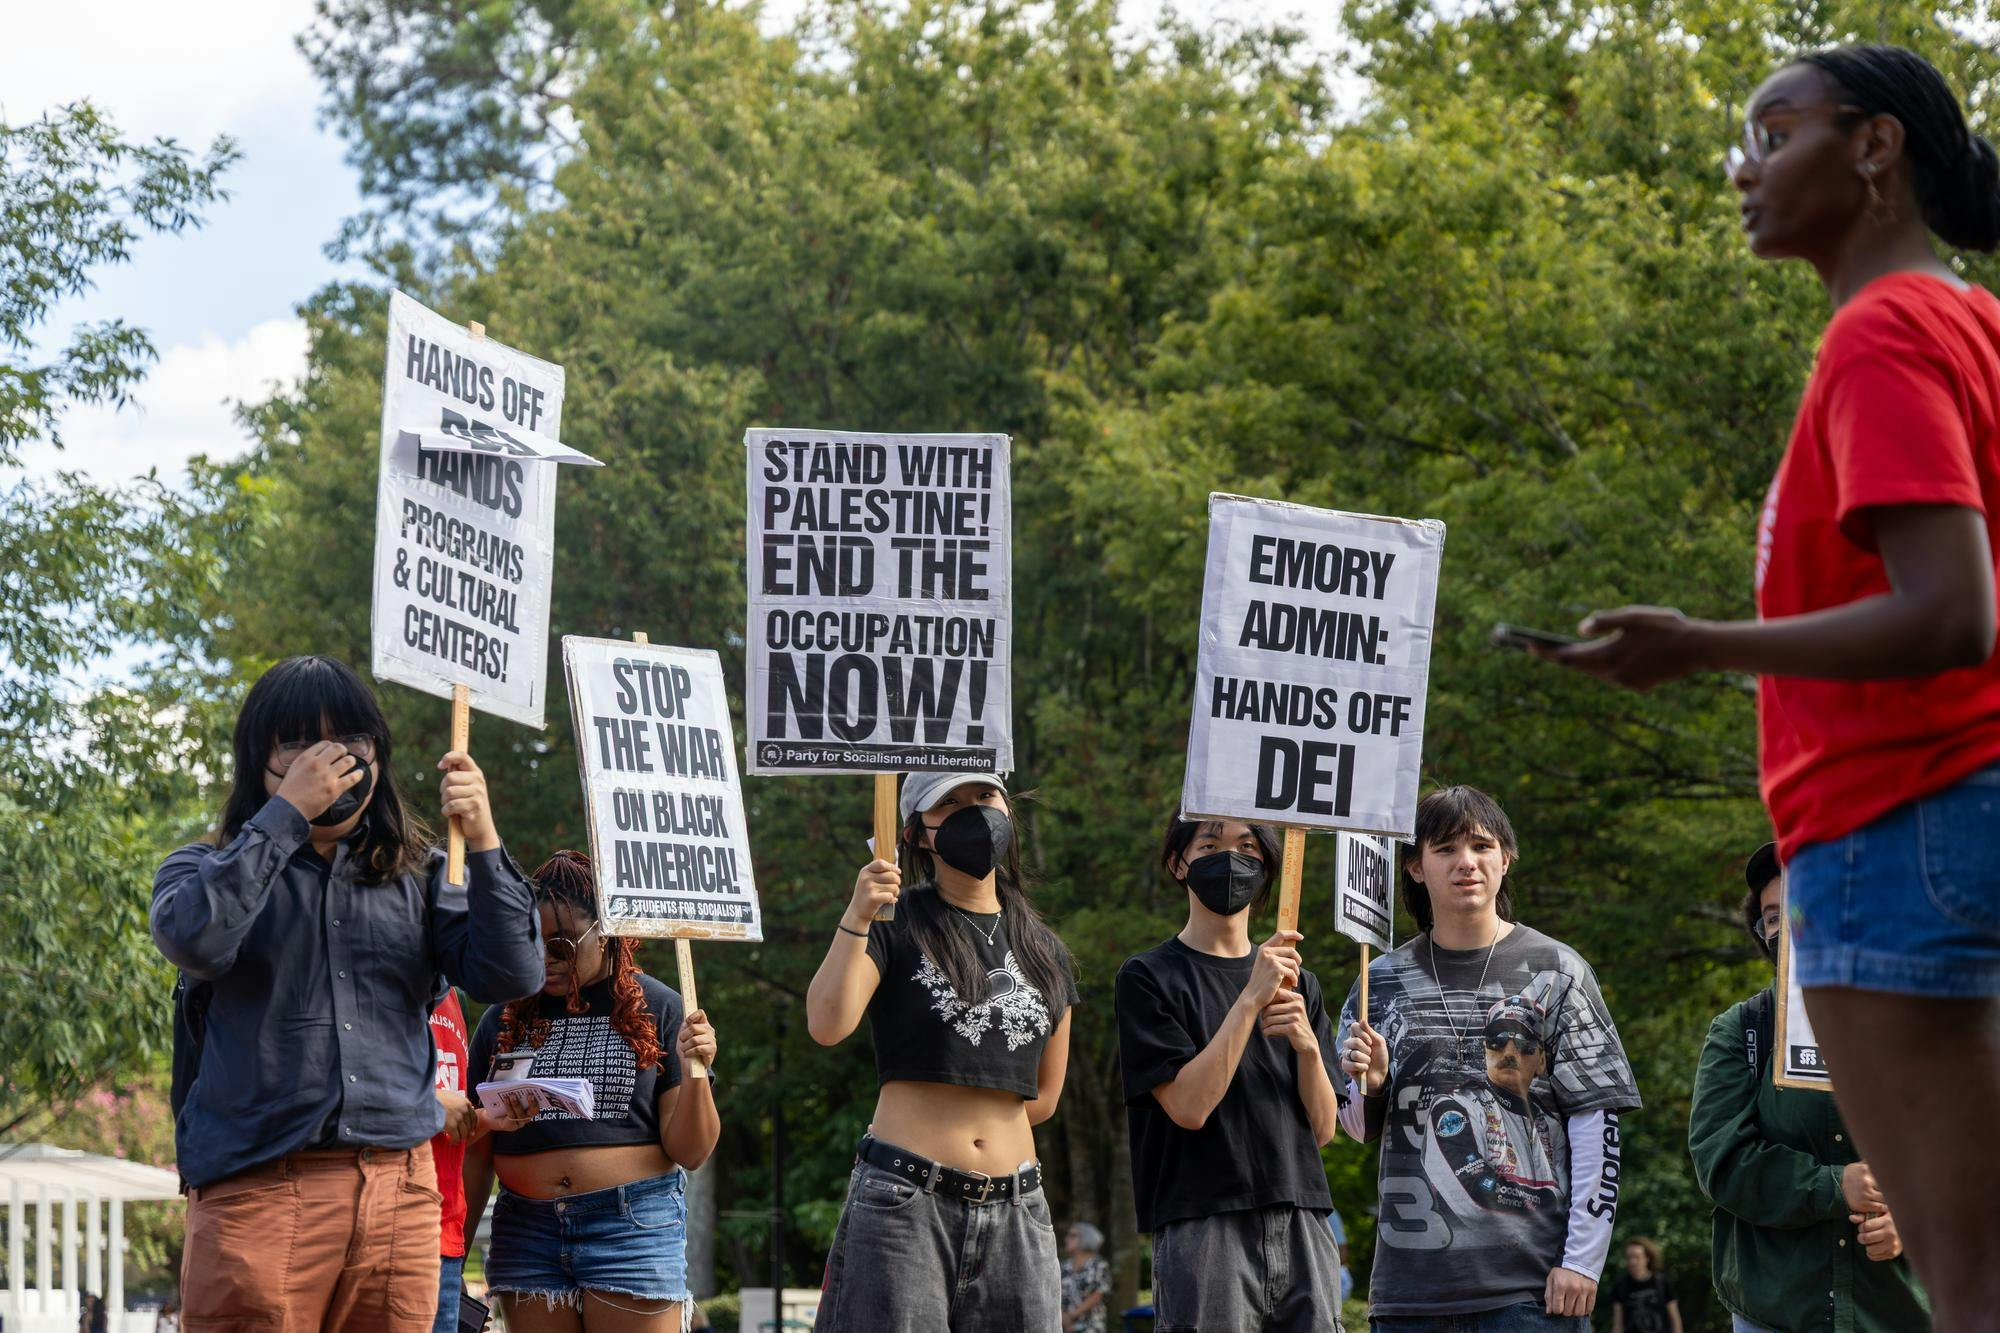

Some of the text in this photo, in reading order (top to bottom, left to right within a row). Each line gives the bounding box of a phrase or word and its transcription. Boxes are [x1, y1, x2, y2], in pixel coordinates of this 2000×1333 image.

[407, 334, 544, 432] HANDS OFF
[764, 440, 992, 489] STAND WITH
[764, 486, 990, 536] PALESTINE!
[400, 498, 524, 585] PROGRAMS
[762, 534, 990, 600] END THE
[1249, 534, 1396, 600] EMORY
[393, 548, 520, 635] & CULTURAL
[404, 604, 508, 683] CENTERS!
[766, 610, 996, 658] OCCUPATION
[1238, 600, 1388, 666] ADMIN:
[612, 658, 692, 720] STOP
[766, 652, 988, 746] NOW!
[1211, 676, 1412, 736] HANDS OFF
[593, 716, 654, 774] THE
[656, 722, 728, 782] WAR
[786, 750, 818, 763] Party
[822, 750, 840, 762] for
[842, 751, 901, 764] Socialism
[904, 752, 928, 764] and
[930, 752, 991, 768] Liberation
[1255, 736, 1356, 818] DEI
[613, 786, 729, 838] ON BLACK
[614, 840, 740, 894] AMERICA!
[632, 899, 742, 917] STUDENTS FOR SOCIALISM
[605, 1076, 636, 1085] MATTER
[606, 1051, 636, 1059] MATTER
[606, 1058, 636, 1067] MATTER
[606, 1067, 636, 1076] MATTER
[1800, 1052, 1816, 1066] SFS
[604, 1085, 634, 1094] MATTER
[1379, 1176, 1452, 1249] 3
